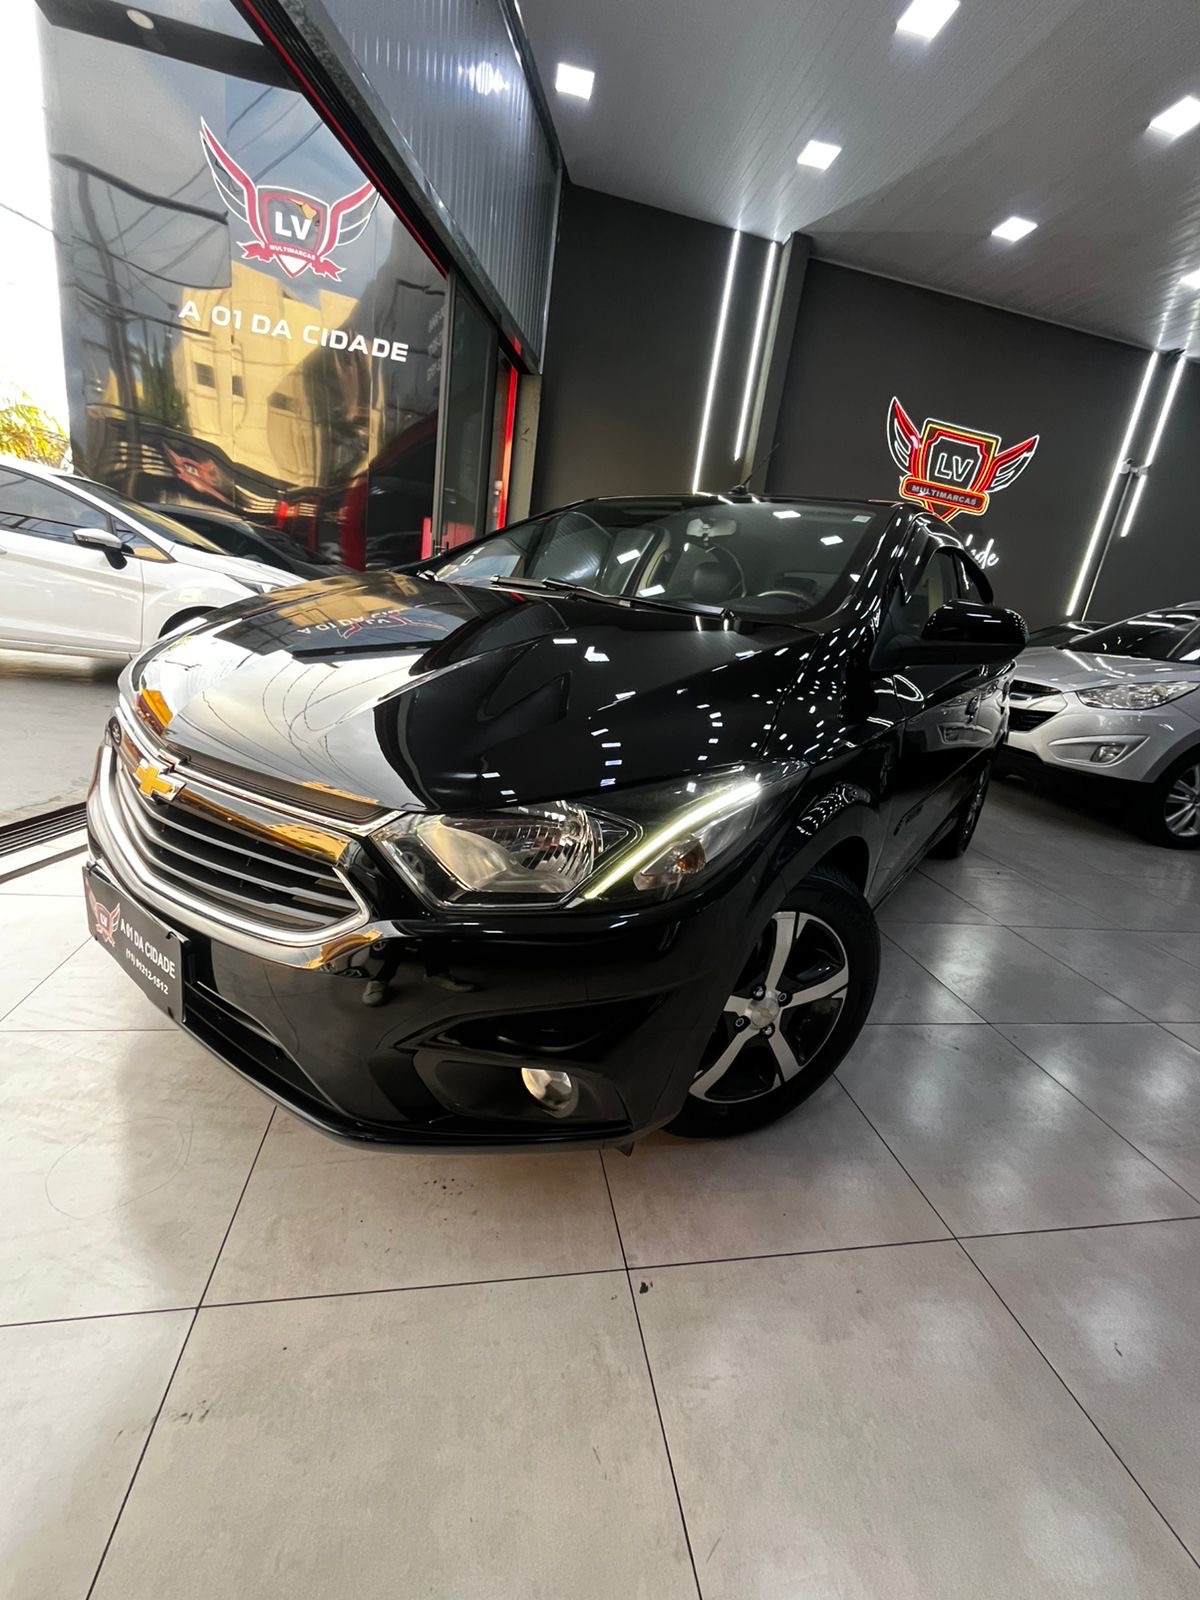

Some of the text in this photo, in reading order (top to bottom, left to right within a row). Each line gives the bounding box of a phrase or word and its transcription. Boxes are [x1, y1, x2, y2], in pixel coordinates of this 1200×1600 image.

[275, 211, 313, 241] LV
[269, 244, 316, 261] MULTIMARCAS
[178, 300, 200, 321] A
[250, 313, 293, 340] DA
[303, 325, 409, 362] CIDADE
[935, 453, 975, 483] LV
[911, 485, 978, 506] MULTIMARCAS
[121, 918, 126, 933] A
[134, 931, 145, 953] DA
[145, 941, 176, 980] CIDADE
